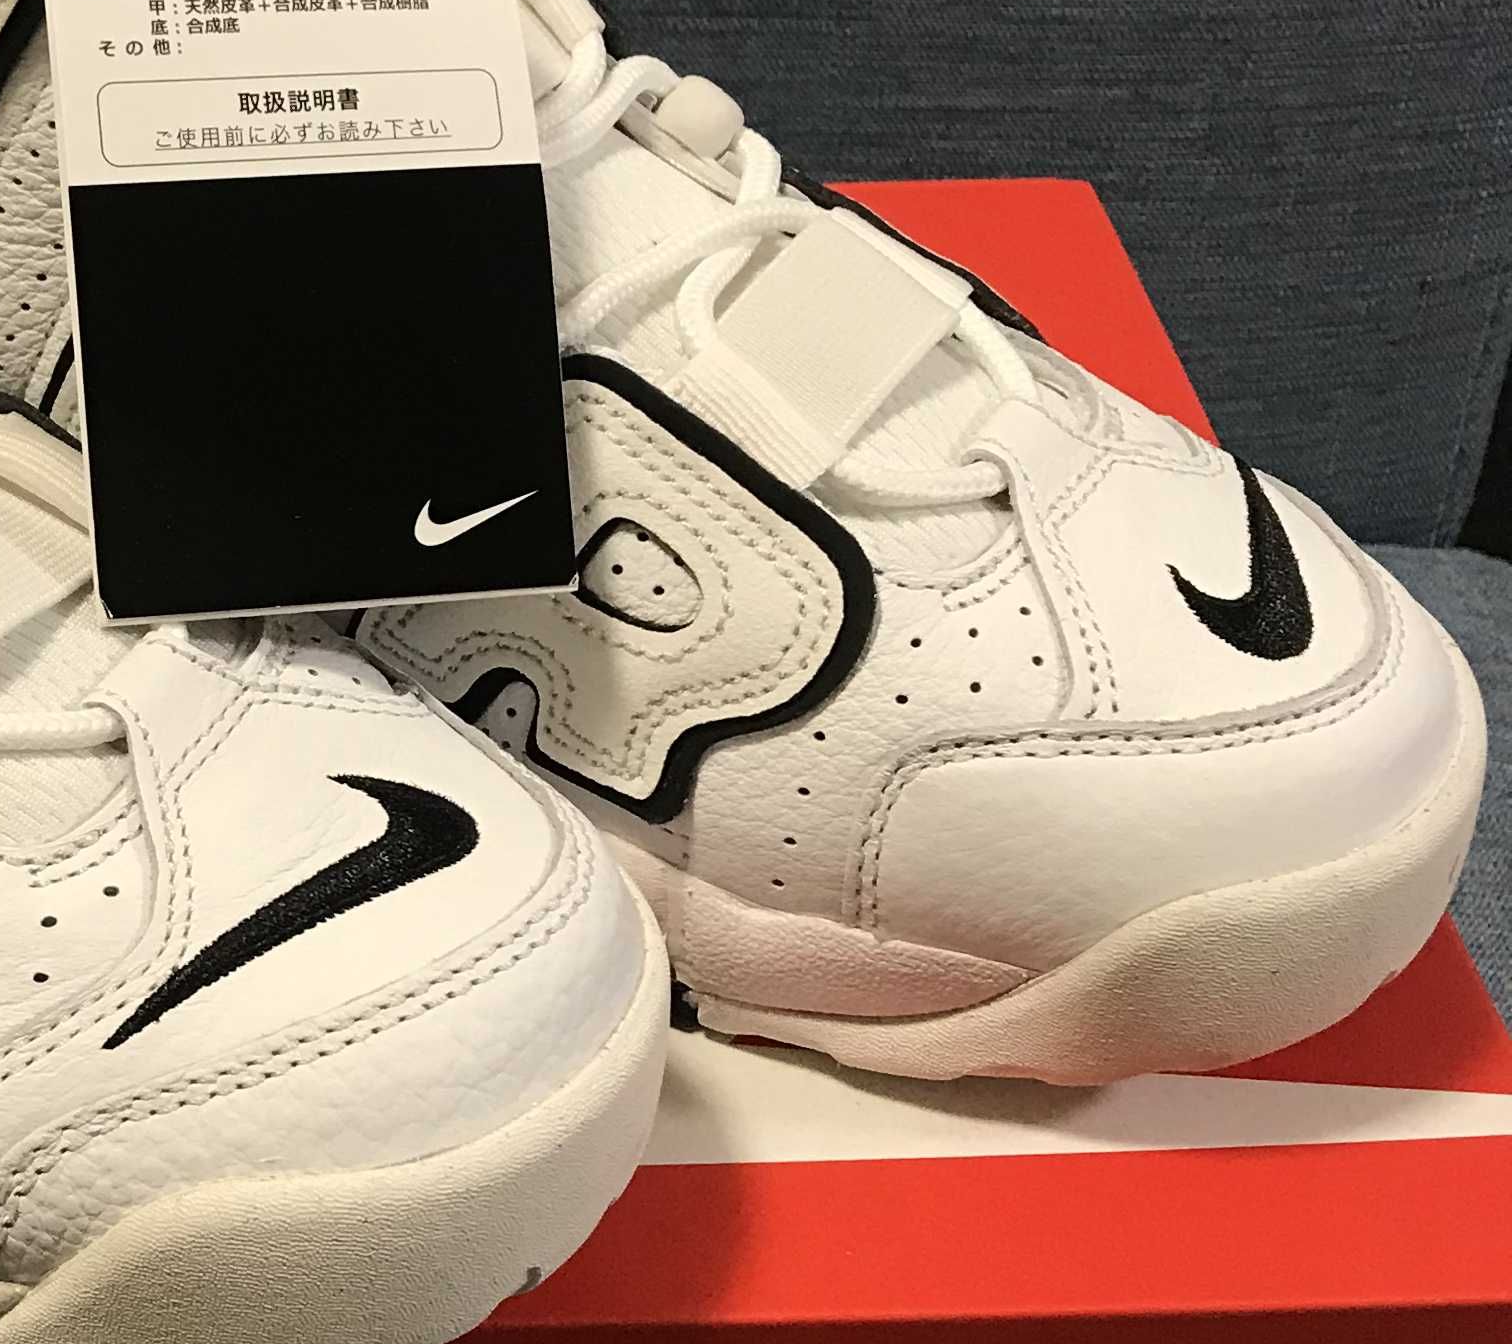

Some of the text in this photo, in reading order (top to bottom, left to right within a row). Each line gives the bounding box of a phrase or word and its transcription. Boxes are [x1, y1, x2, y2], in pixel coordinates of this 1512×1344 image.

[238, 88, 360, 115] 取扱説明書
[155, 116, 449, 149] ご使用前に必ずお読み下さい
